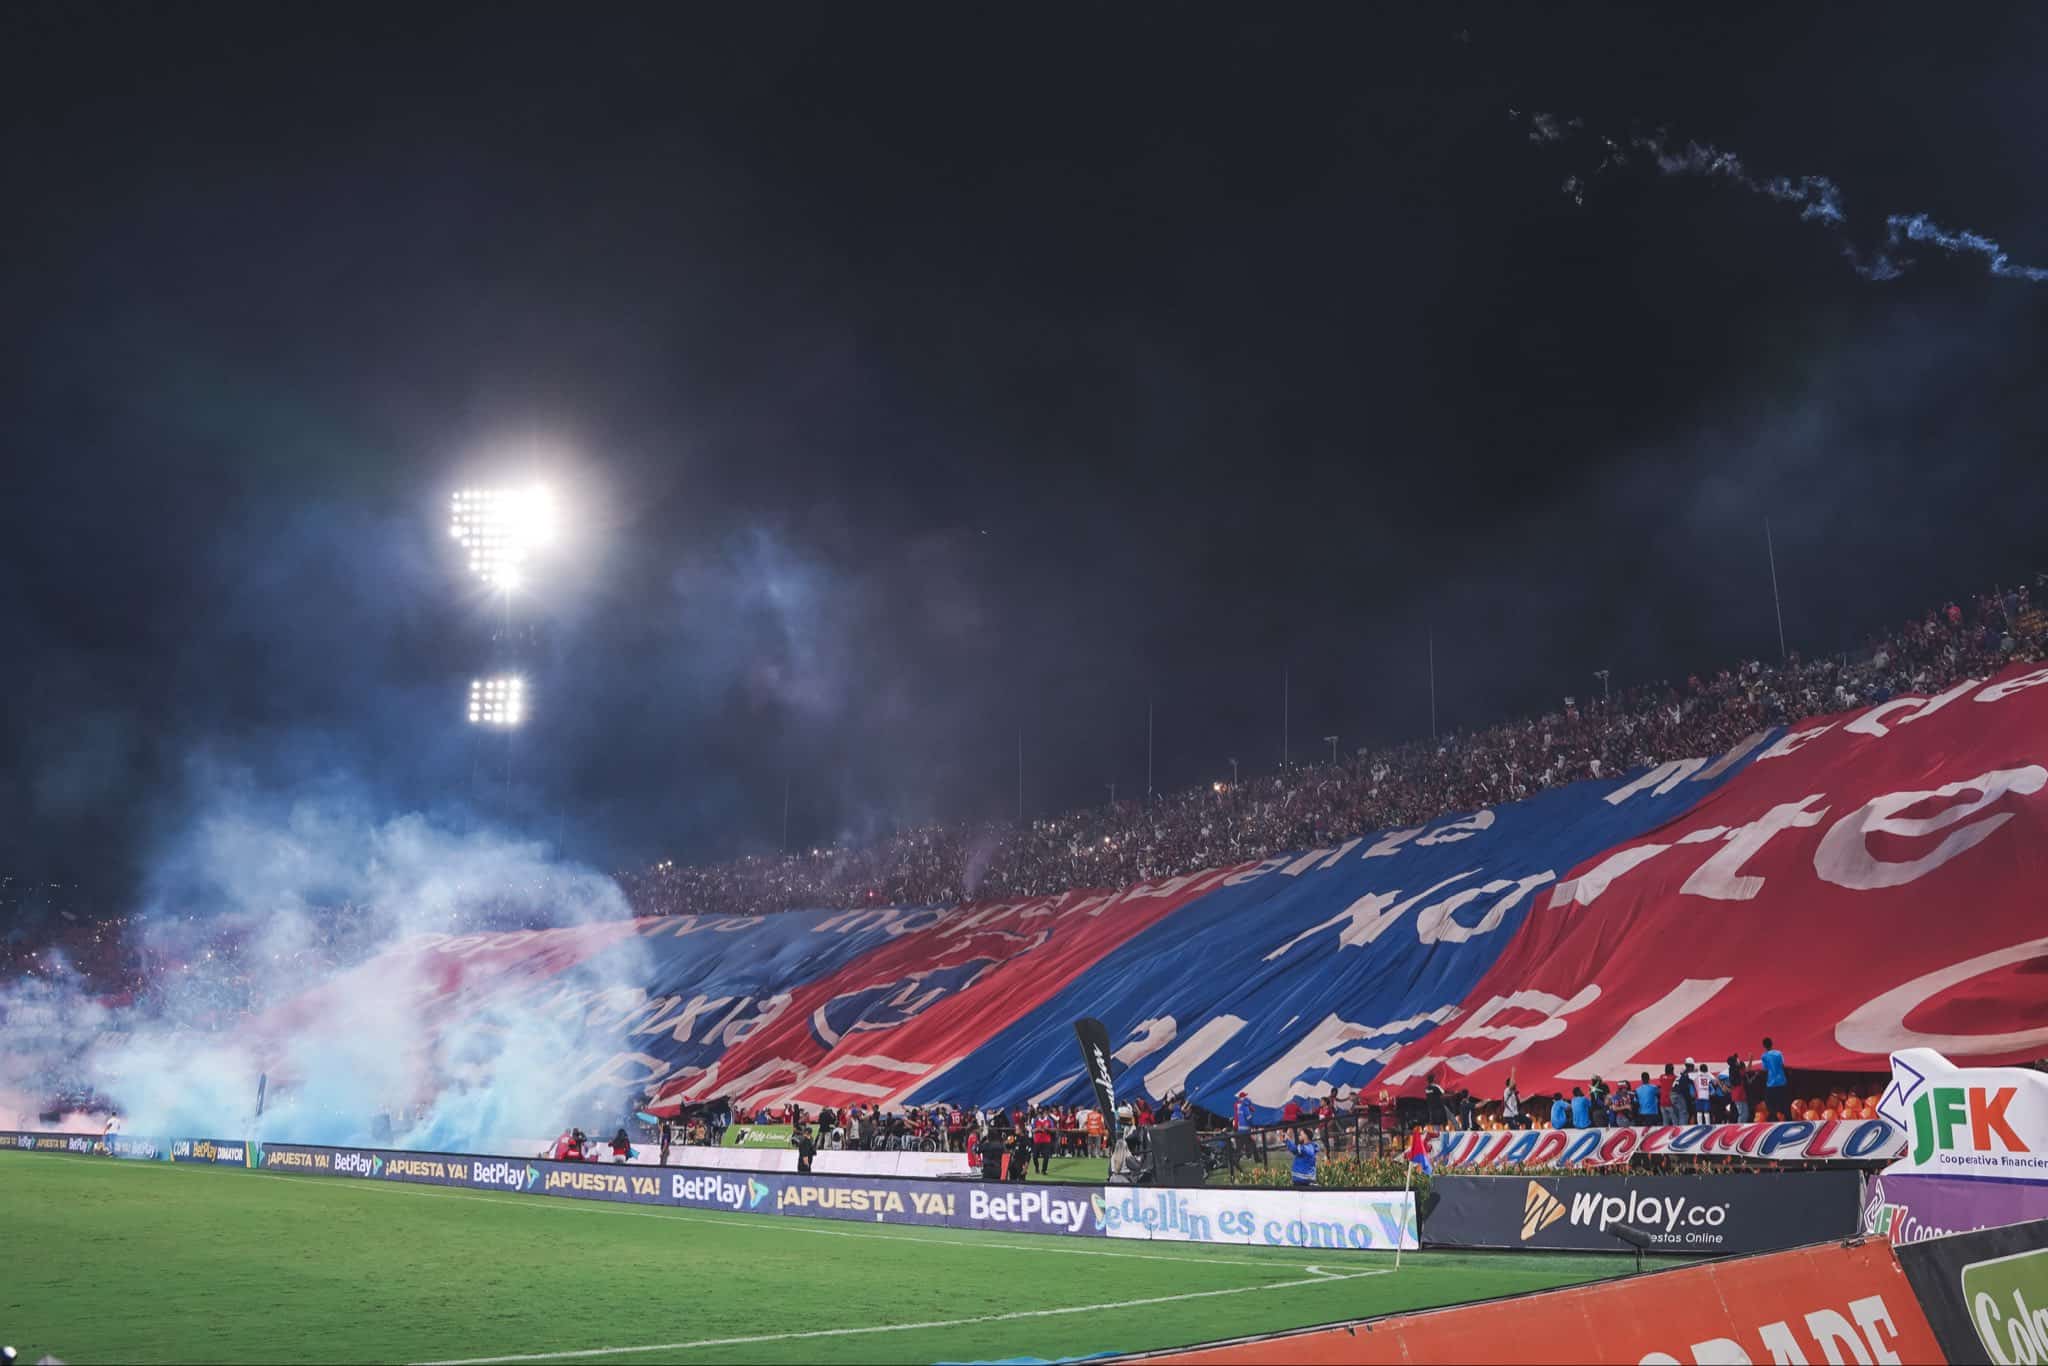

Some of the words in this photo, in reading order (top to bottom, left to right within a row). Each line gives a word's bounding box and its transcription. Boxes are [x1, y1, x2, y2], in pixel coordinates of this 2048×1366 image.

[1640, 1118, 1909, 1158] COMPLO
[1913, 1087, 2031, 1166] JFK
[173, 1140, 190, 1157] COPA
[1940, 1154, 1998, 1167] Cooperativa
[267, 1152, 312, 1168] ¡APUESTA
[314, 1154, 329, 1169] YA!
[334, 1152, 372, 1176] BetPlay
[385, 1161, 444, 1178] ¡APUESTA
[447, 1164, 468, 1180] YA!
[473, 1162, 525, 1191] BetPlay
[545, 1171, 628, 1195] ¡APUESTA
[630, 1175, 661, 1196] YA!
[672, 1174, 746, 1210] BetPlay
[777, 1185, 905, 1214] ¡APUESTA
[909, 1191, 955, 1216] YA!
[969, 1189, 1088, 1232] BetPlay
[1570, 1189, 1726, 1233] Wplay.co
[1102, 1188, 1212, 1240] edellín
[1218, 1208, 1256, 1237] es
[1263, 1216, 1374, 1248] como
[1650, 1233, 1682, 1243] estas
[1685, 1232, 1724, 1244] Online
